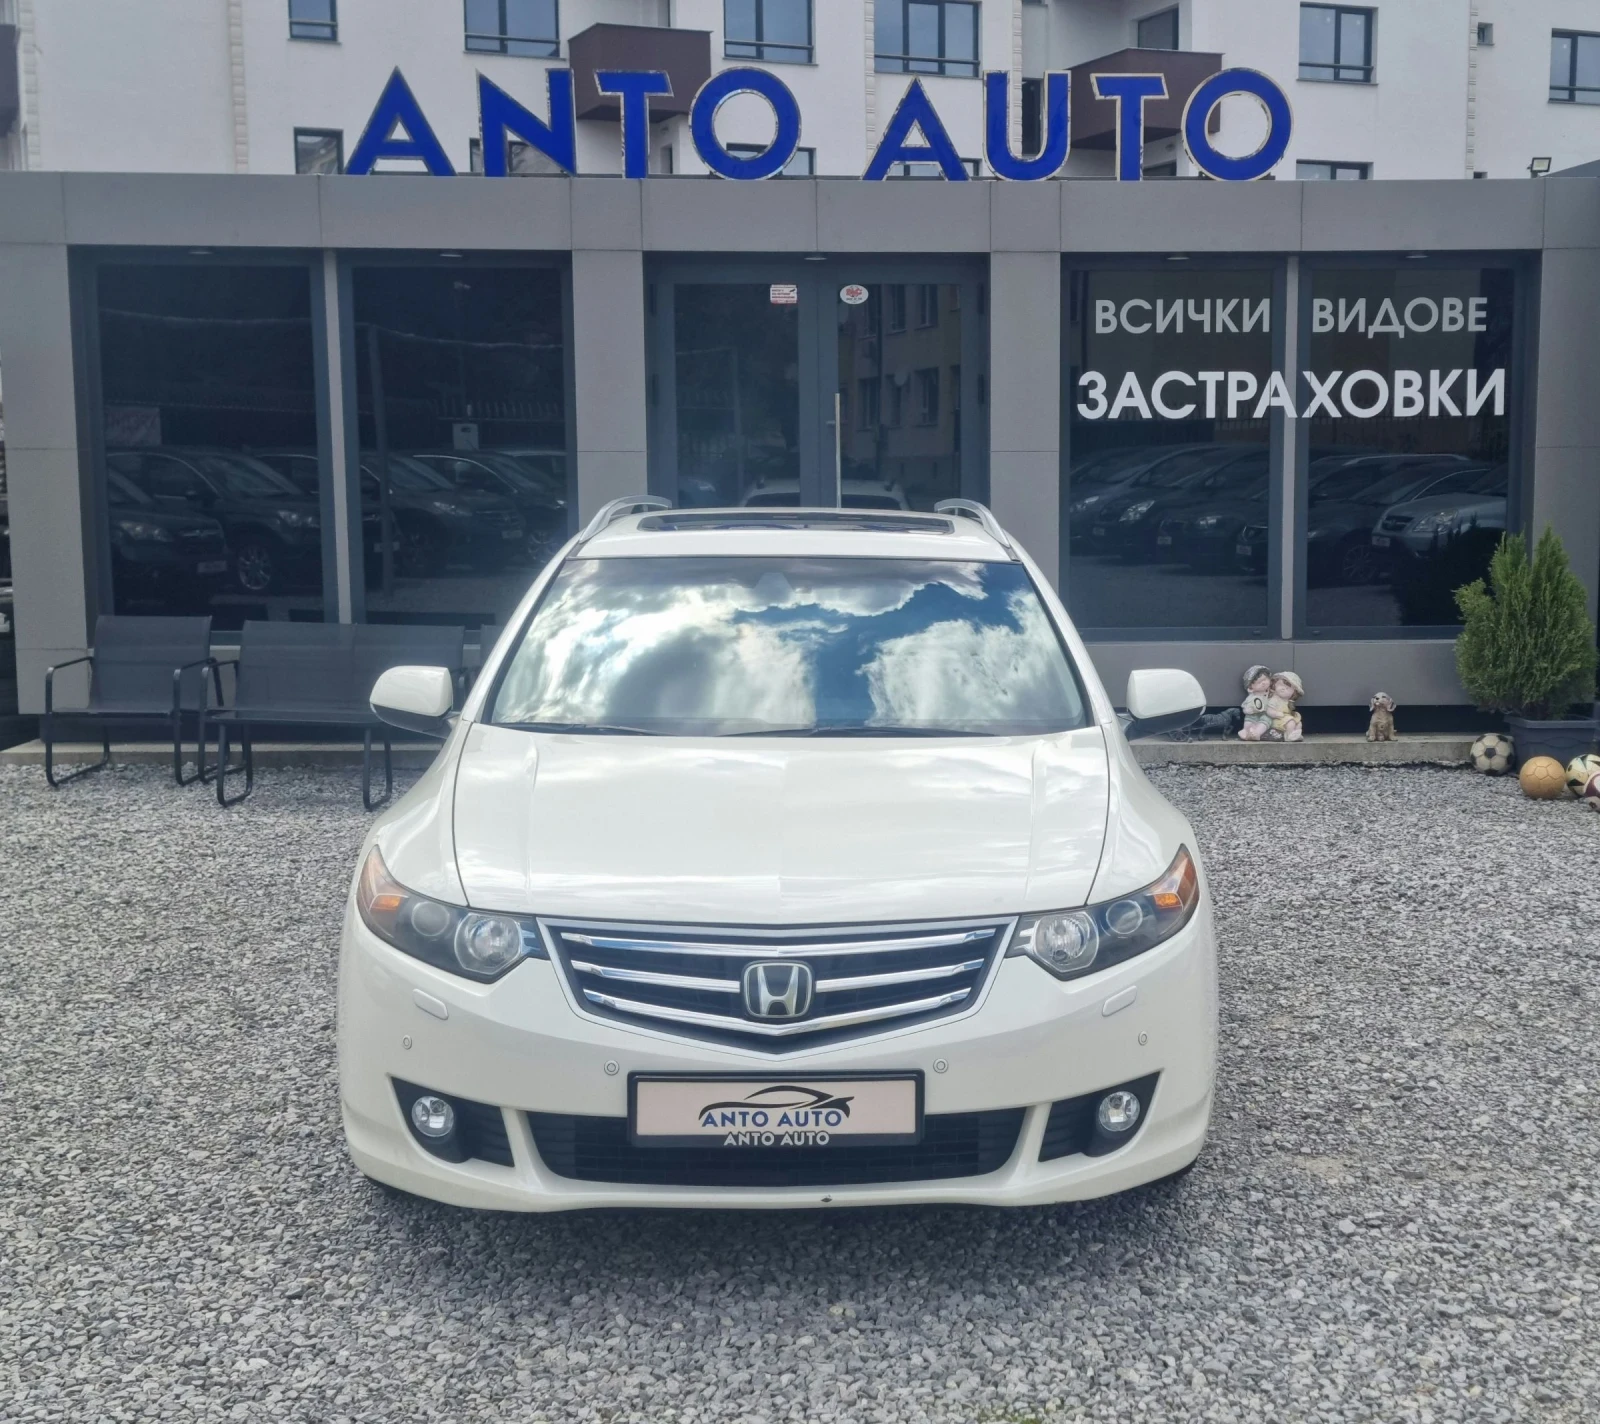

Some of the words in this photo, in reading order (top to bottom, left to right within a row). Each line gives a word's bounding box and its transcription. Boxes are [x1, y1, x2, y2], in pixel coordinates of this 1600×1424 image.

[344, 66, 802, 180] ANTO
[860, 67, 1295, 181] AUTO
[1095, 298, 1271, 334] ВСИЧКИ
[1311, 297, 1488, 339] ВИДОВЕ
[1076, 368, 1506, 420] ЗАСТРАХОВКИ
[701, 1110, 769, 1128] ANTO
[776, 1110, 842, 1128] AUTO
[723, 1130, 775, 1146] ANTO
[780, 1130, 830, 1146] AUTO
